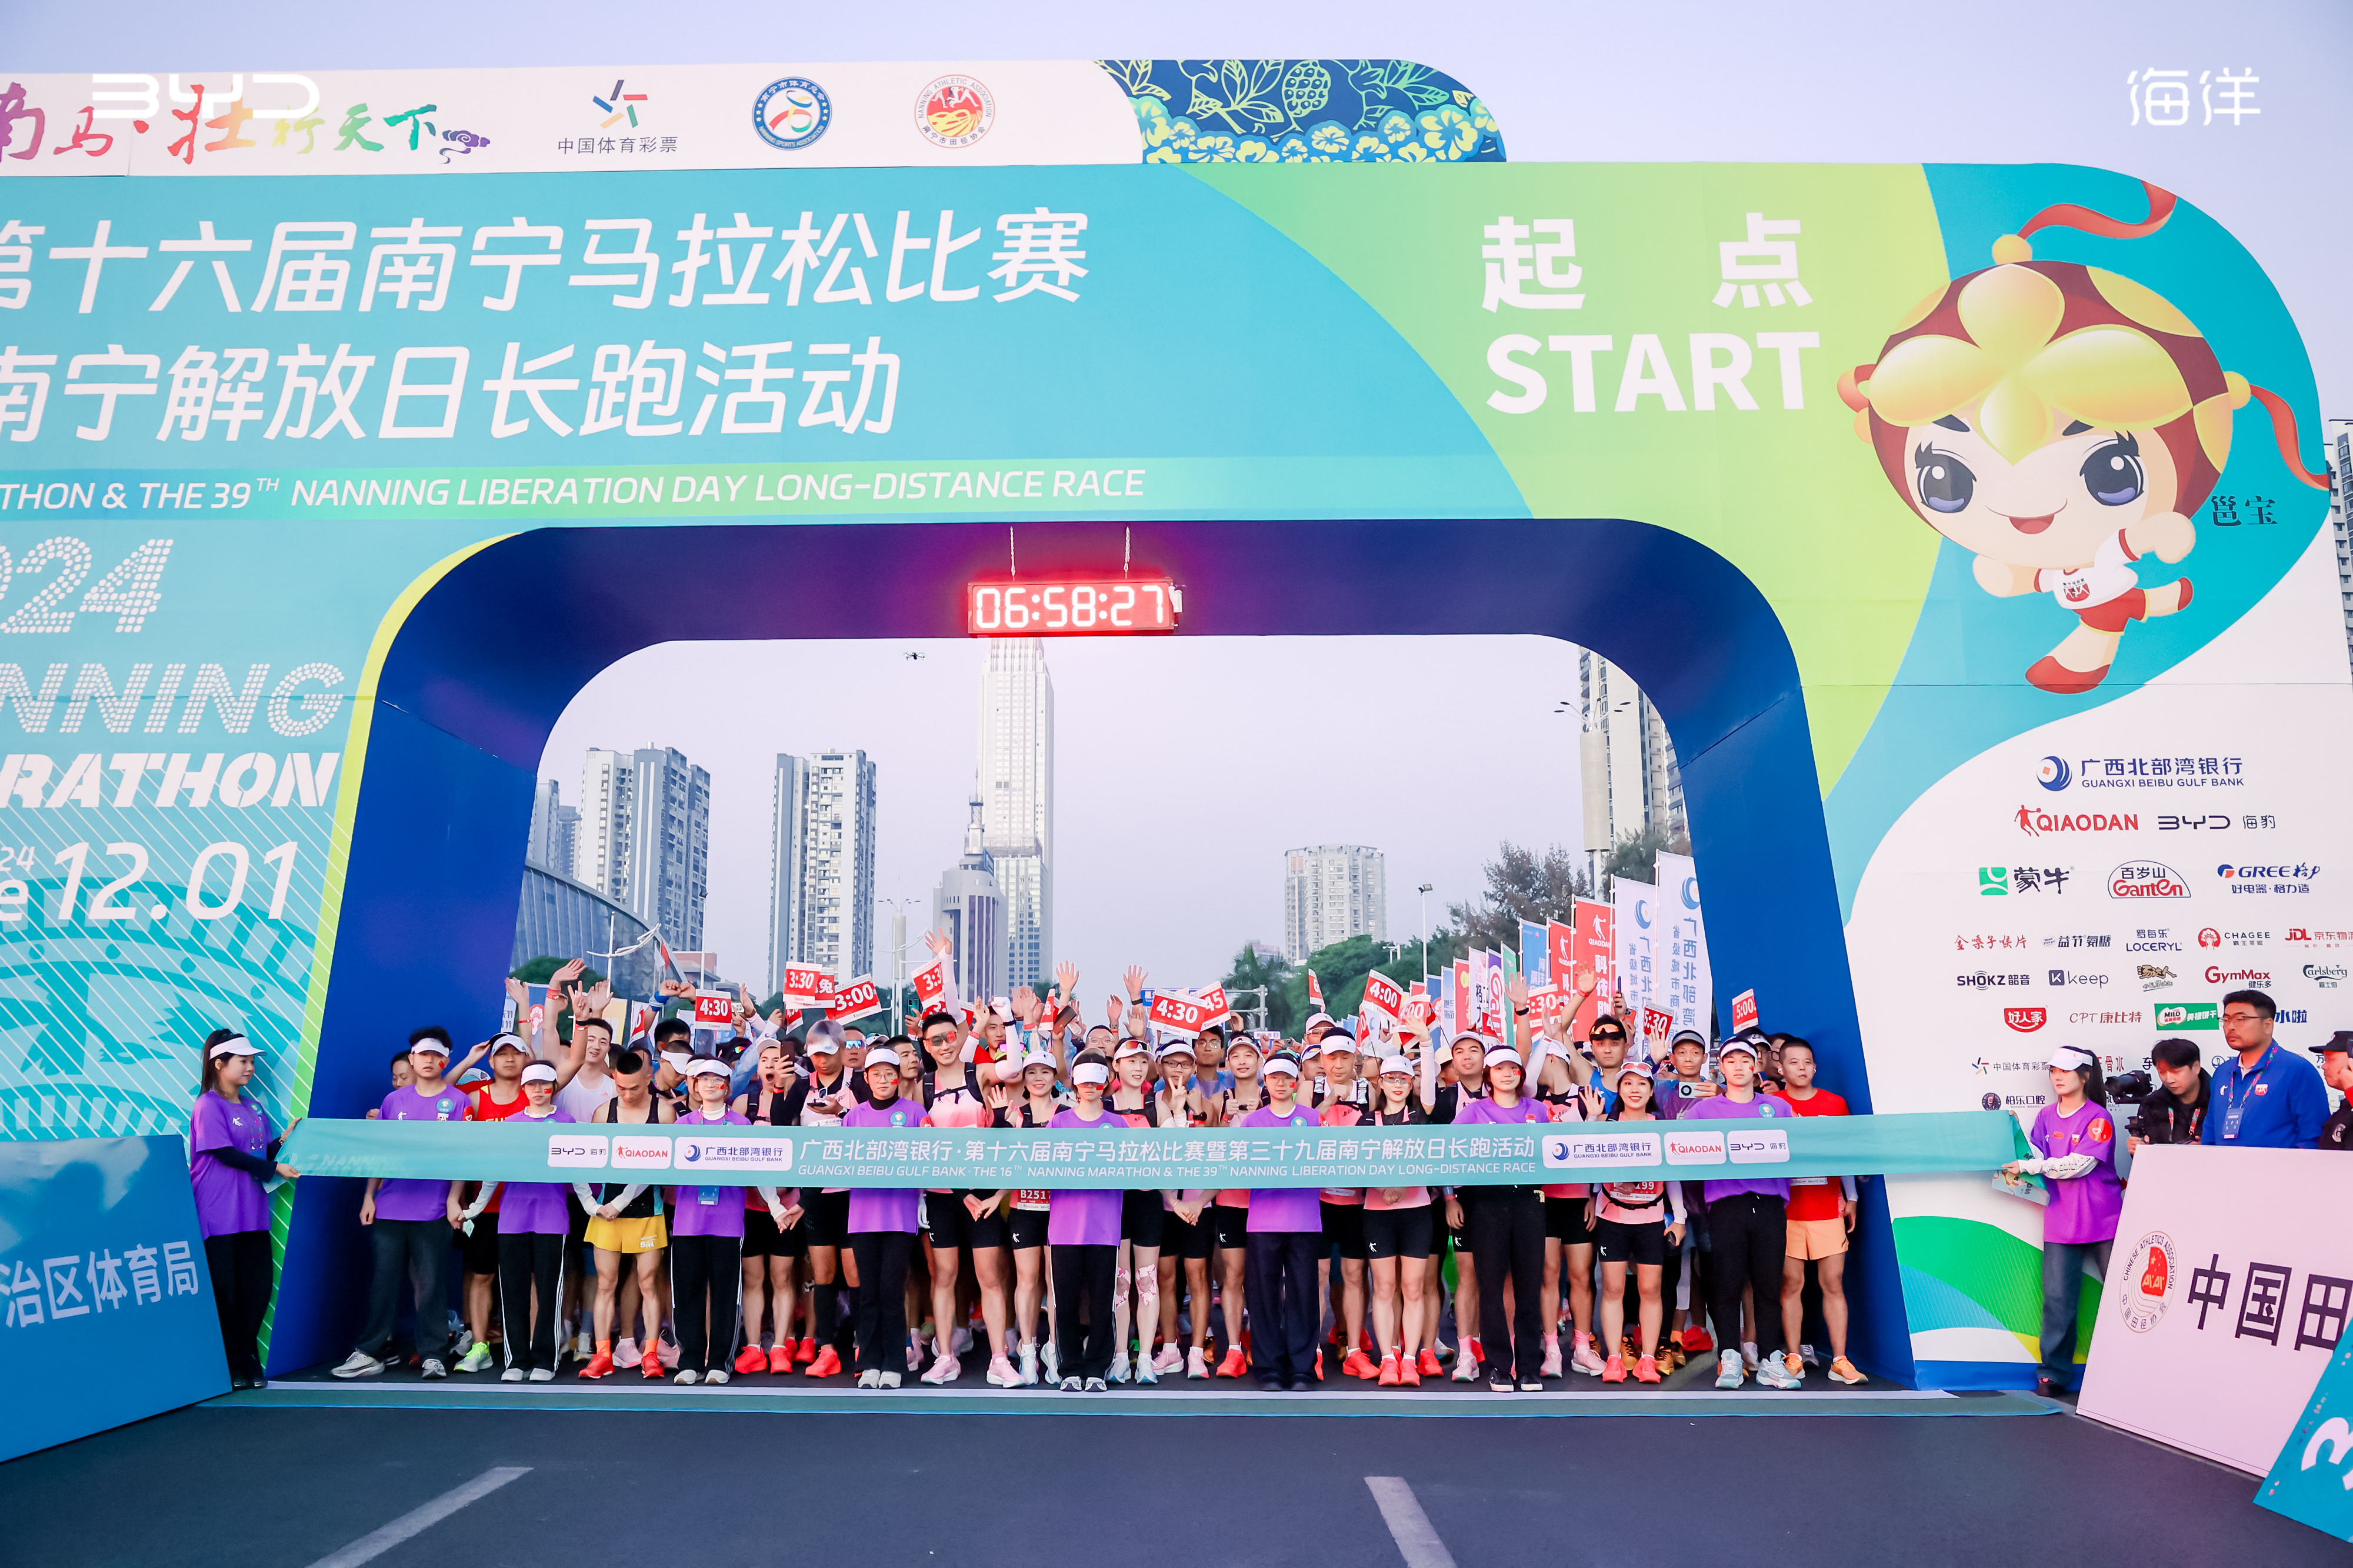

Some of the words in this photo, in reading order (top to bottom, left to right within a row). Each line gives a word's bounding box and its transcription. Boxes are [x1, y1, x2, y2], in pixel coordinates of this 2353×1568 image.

[918, 89, 932, 118] NANNING
[934, 78, 968, 90] ATHLETIC
[970, 82, 992, 117] ASSOCIATION
[558, 136, 678, 154] 中国体育彩票
[1482, 216, 1585, 313] 起
[1712, 212, 1813, 308] 点
[1487, 332, 1820, 414] START
[102, 483, 127, 509] &
[139, 483, 206, 509] THE
[292, 479, 450, 506] NANNING
[458, 476, 664, 505] LIBERATION
[672, 475, 746, 502] DAY
[756, 471, 1044, 501] LONG-DISTANCE
[1053, 470, 1145, 496] RACE
[2209, 494, 2278, 527] 邕宝
[0, 536, 174, 633] 24
[975, 583, 1164, 628] 06:58:27
[2082, 758, 2242, 776] 广西北部湾银行
[2082, 779, 2134, 788] GUANGXI
[2037, 813, 2139, 833] QIAODAN
[2158, 816, 2231, 830] BYD
[2243, 815, 2275, 829] 海豹
[54, 841, 298, 920] 12.01
[2013, 866, 2069, 895] 蒙牛
[2121, 867, 2166, 880] 百岁山
[2238, 866, 2290, 879] GREE
[1955, 935, 2026, 950] 金嗓子喉片
[2285, 928, 2312, 941] JDL
[2126, 942, 2182, 952] LOCERYL
[789, 971, 814, 989] 3:30
[1957, 975, 2006, 986] SHOKZ
[2068, 971, 2109, 989] keep
[2205, 966, 2271, 983] GymMax
[835, 984, 874, 1011] 3:00
[1369, 981, 1398, 1008] 4:00
[700, 999, 728, 1017] 4:30
[1156, 999, 1198, 1023] 4:30
[1737, 998, 1754, 1019] 5:00
[2008, 1011, 2044, 1023] 好人家
[2069, 1013, 2098, 1024] CPT
[2099, 1012, 2142, 1024] 康比特
[2097, 1056, 2124, 1072] 骨水
[2005, 1095, 2045, 1105] 柏乐口腔
[590, 1148, 606, 1156] 海豹
[625, 1149, 668, 1159] QIAODAN
[705, 1146, 783, 1157] 广西北部湾银行
[1574, 1142, 1652, 1153] 广西北部湾银行
[1678, 1145, 1722, 1154] QIAODAN
[1770, 1142, 1787, 1150] 海豹
[798, 1165, 855, 1175] GUANGXI
[857, 1166, 894, 1176] BEIBU
[896, 1166, 929, 1176] GULF
[932, 1166, 966, 1176] BANK
[973, 1167, 997, 1176] THE
[1028, 1167, 1085, 1177] NANNING
[1088, 1167, 1161, 1177] MARATHON
[1164, 1167, 1174, 1177] &
[1177, 1167, 1201, 1176] THE
[1230, 1166, 1287, 1176] NANNING
[1292, 1165, 1366, 1176] LIBERATION
[1369, 1165, 1395, 1175] DAY
[1399, 1163, 1500, 1175] LONG-DISTANCE
[1504, 1162, 1535, 1172] RACE
[1021, 1189, 1050, 1200] B251
[2124, 1248, 2139, 1281] CHINESE
[2140, 1235, 2165, 1252] ATHLETICS
[2164, 1240, 2175, 1289] ASSOCIATION
[0, 1240, 199, 1328] 治区体育局
[2188, 1253, 2353, 1352] 中国田
